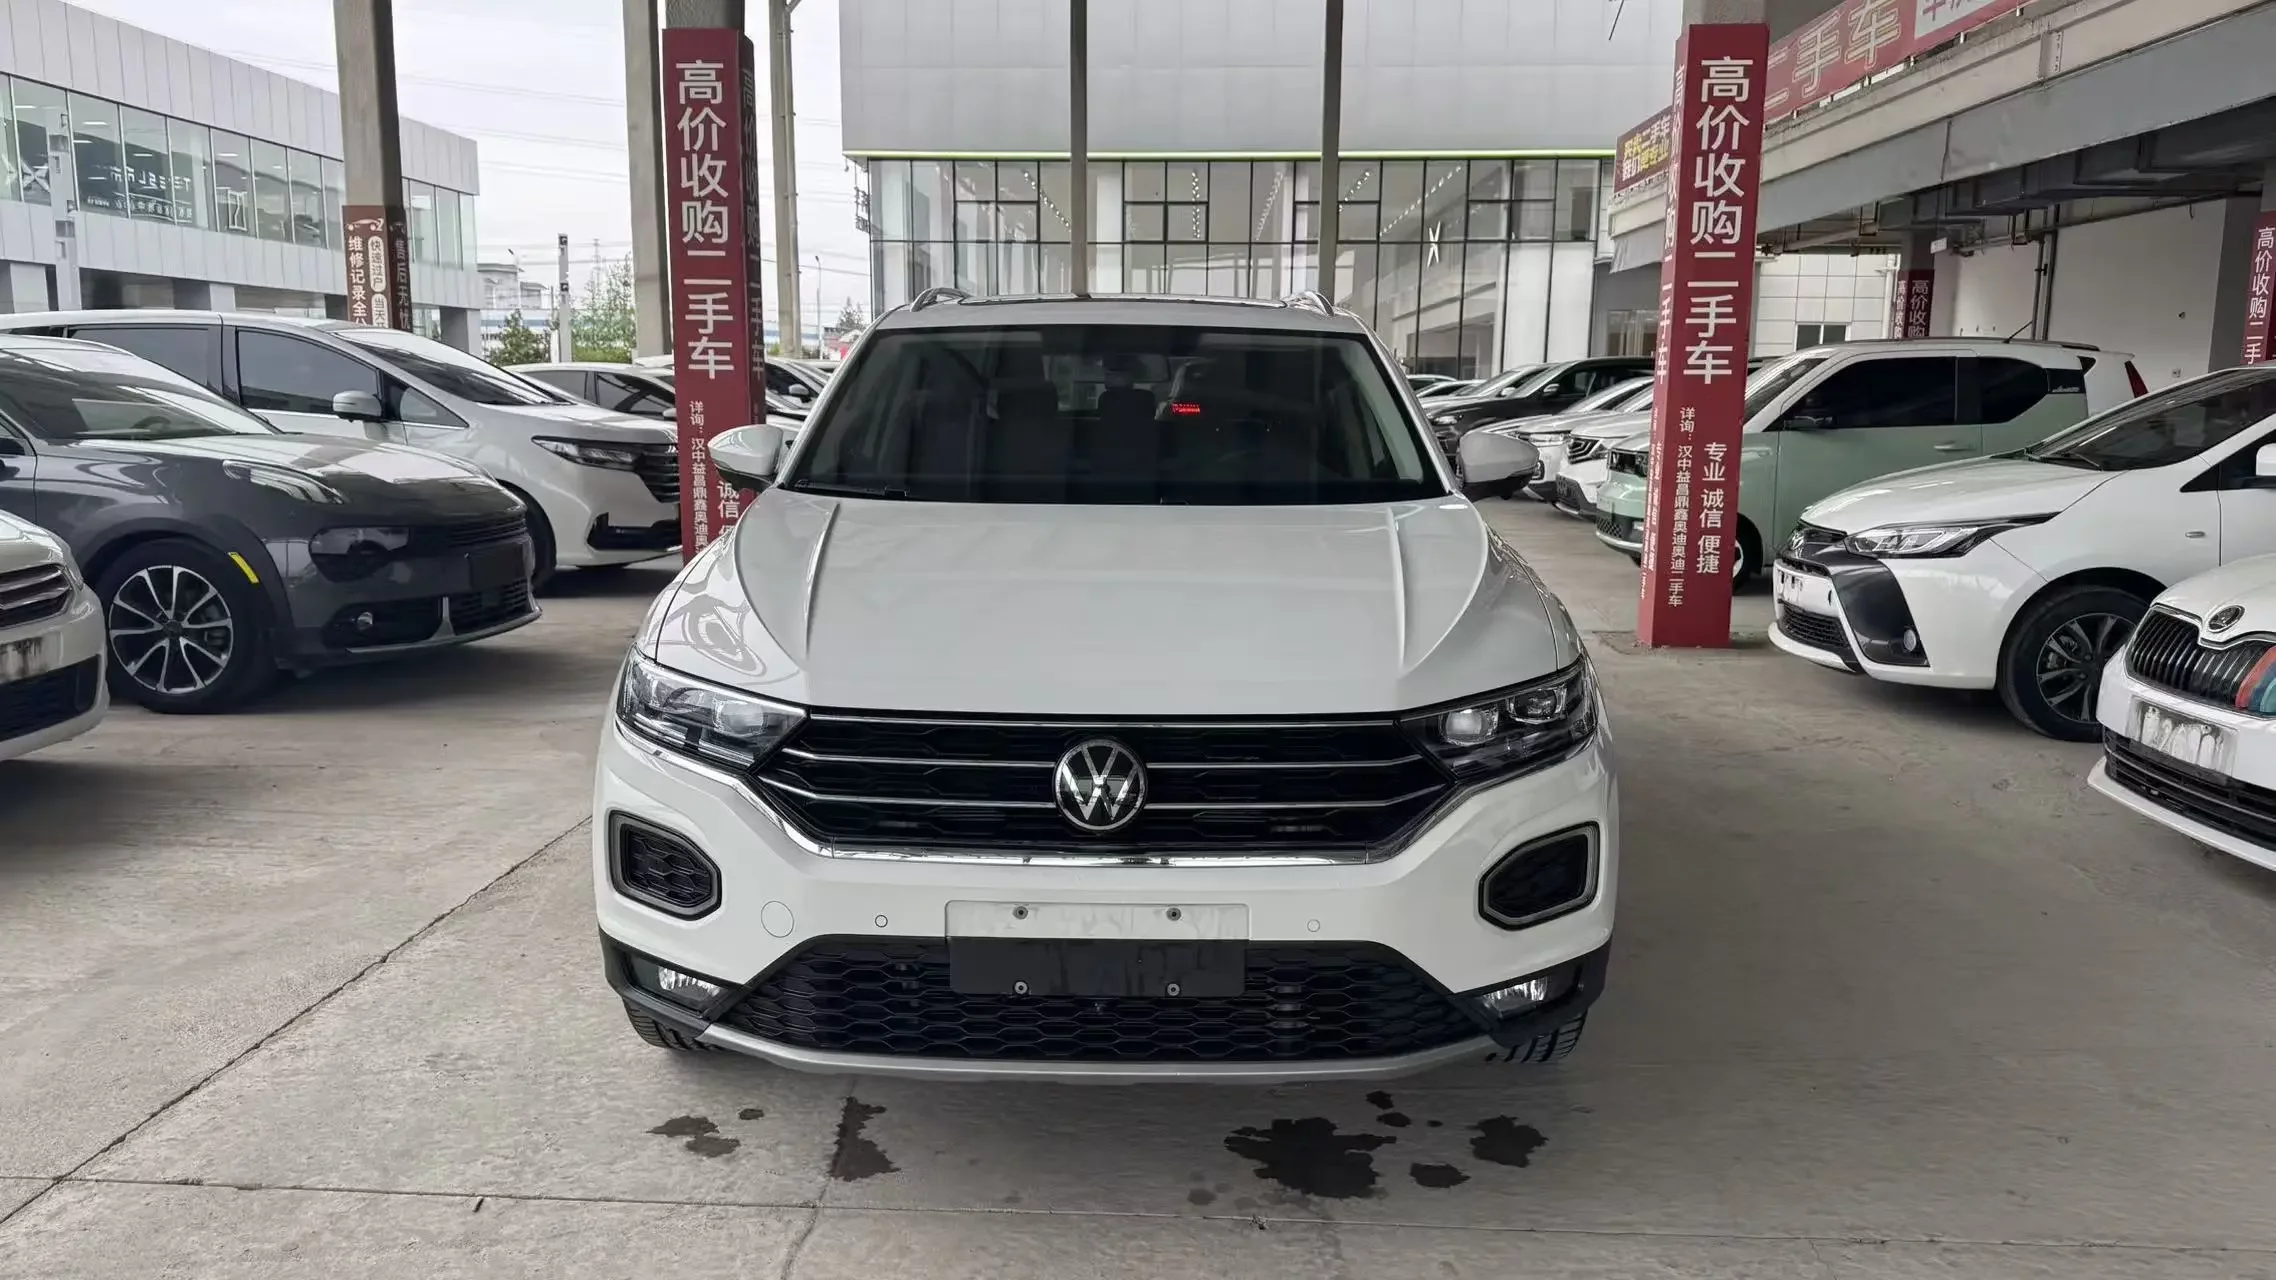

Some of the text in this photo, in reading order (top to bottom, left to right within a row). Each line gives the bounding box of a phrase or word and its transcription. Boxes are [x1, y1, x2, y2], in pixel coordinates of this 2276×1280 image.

[370, 240, 384, 285] 快速过户
[676, 60, 734, 379] 高价收购二手车
[1657, 64, 1684, 384] 高价收购二手车
[1683, 56, 1753, 384] 高价收购二手车
[1908, 280, 1929, 337] 高价收购
[2244, 227, 2275, 365] 高价收购二手
[717, 481, 740, 518] 诚信
[1696, 442, 1728, 574] 专业 诚信 便捷
